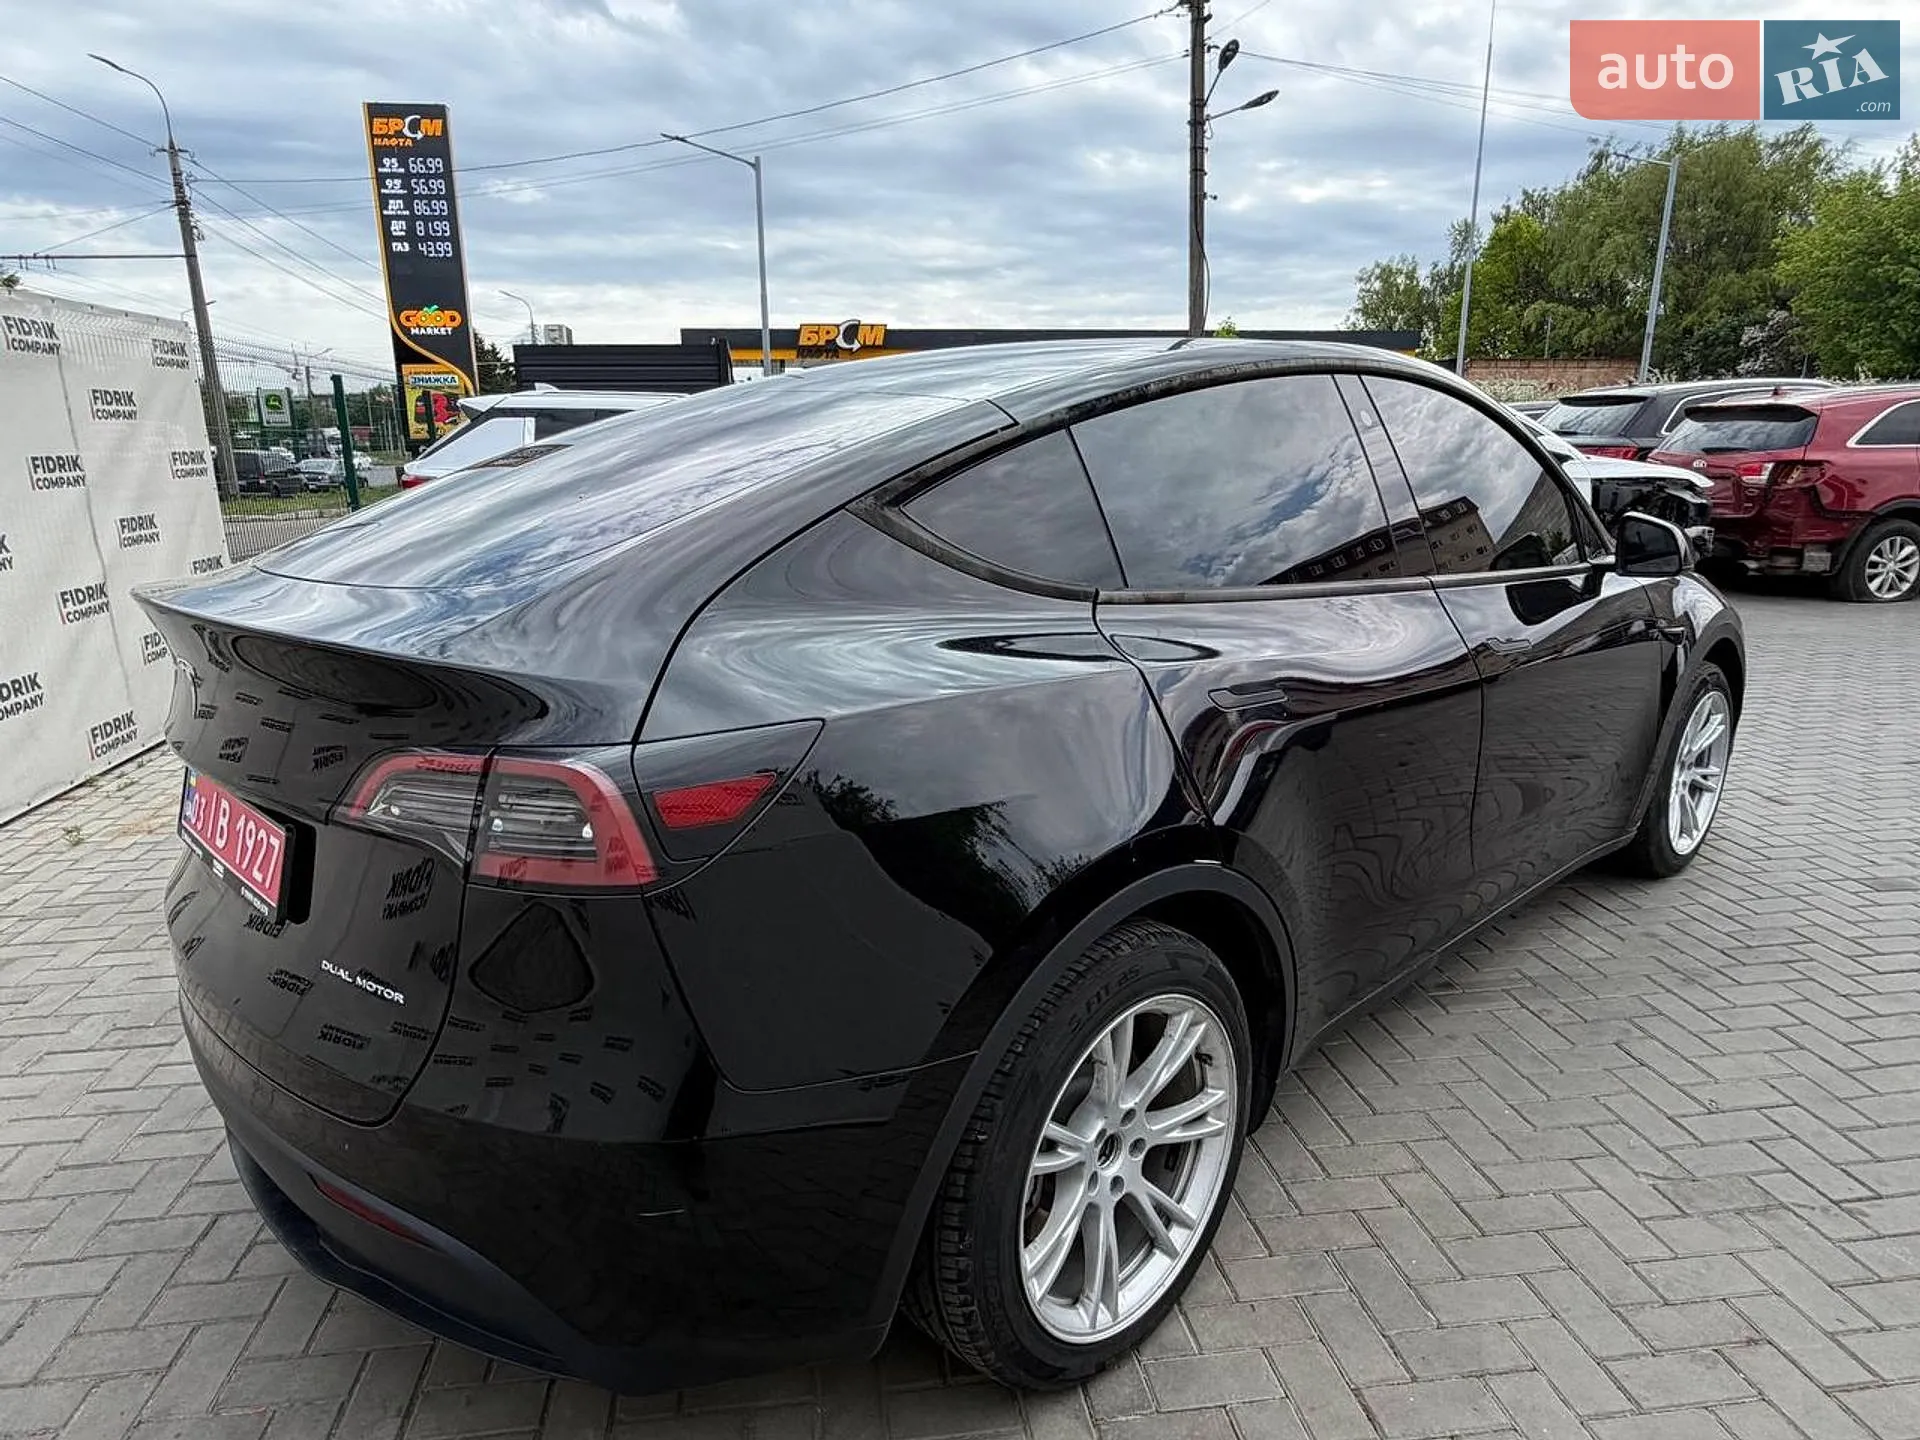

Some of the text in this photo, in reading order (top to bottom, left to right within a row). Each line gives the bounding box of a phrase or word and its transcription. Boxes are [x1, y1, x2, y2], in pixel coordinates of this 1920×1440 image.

[408, 157, 444, 174] 66.99
[411, 178, 446, 195] 56.99
[413, 199, 449, 216] 86.99
[391, 241, 453, 258] ГАЗ 43.99
[3, 315, 59, 341] FIDRIK
[400, 310, 462, 328] GOOD
[410, 327, 453, 336] MARKET
[11, 338, 61, 356] COMPANY
[152, 339, 189, 357] FIDRIK
[155, 357, 190, 370] COMPANY
[91, 388, 137, 407] FIDRIK
[96, 406, 138, 421] COMPANY
[31, 454, 84, 474] FIDRIK
[172, 450, 207, 467] FIDRIK
[175, 466, 209, 480] COMPANY
[35, 474, 87, 491] COMPANY
[119, 513, 158, 533] FIDRIK
[123, 529, 161, 549] COMPANY
[192, 555, 224, 575] FIDRIK
[60, 582, 108, 609] FIDRIK
[66, 600, 110, 623] COMPANY
[90, 710, 137, 744] FIDRIK
[94, 729, 138, 758] COMPANY
[235, 814, 281, 889] 1927
[320, 959, 353, 983] DUAL
[355, 974, 406, 1005] MOTOR
